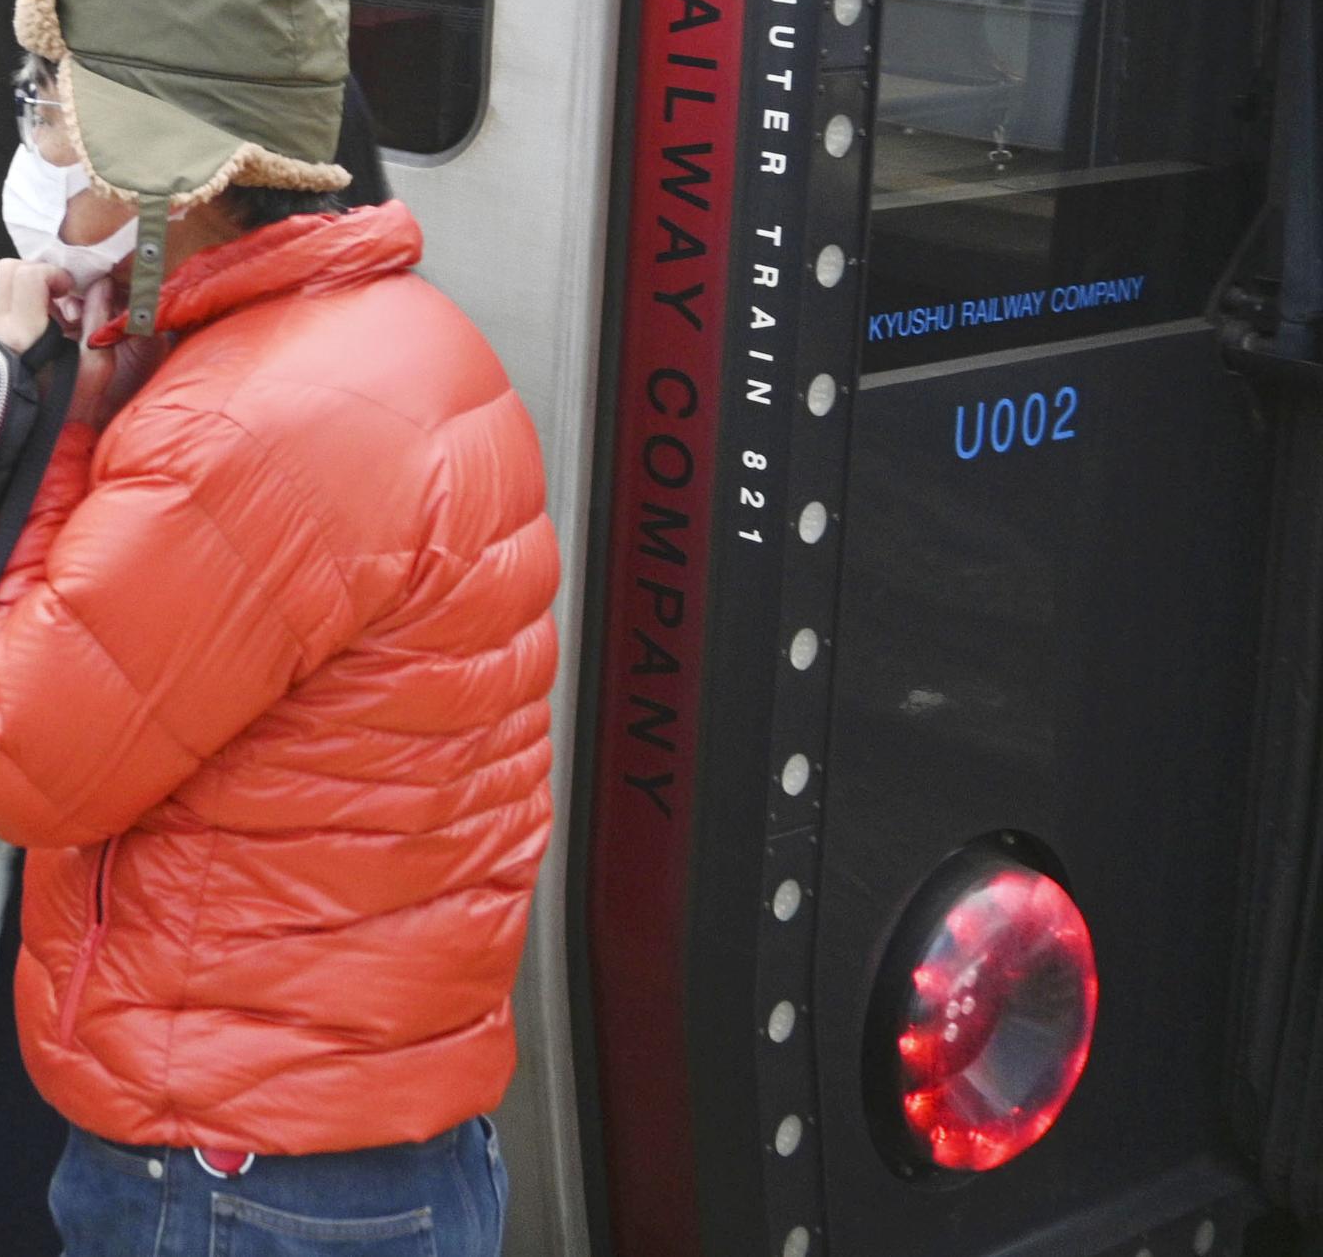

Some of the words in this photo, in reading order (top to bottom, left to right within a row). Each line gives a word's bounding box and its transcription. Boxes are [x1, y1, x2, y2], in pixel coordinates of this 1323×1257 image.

[746, 224, 783, 406] TRAIN
[868, 303, 954, 341] KYUSHU
[961, 290, 1045, 327] RAILWAY
[1050, 275, 1144, 313] COMPANY
[955, 386, 1078, 460] U002
[738, 450, 767, 544] 821
[624, 367, 699, 820] COMPANY
